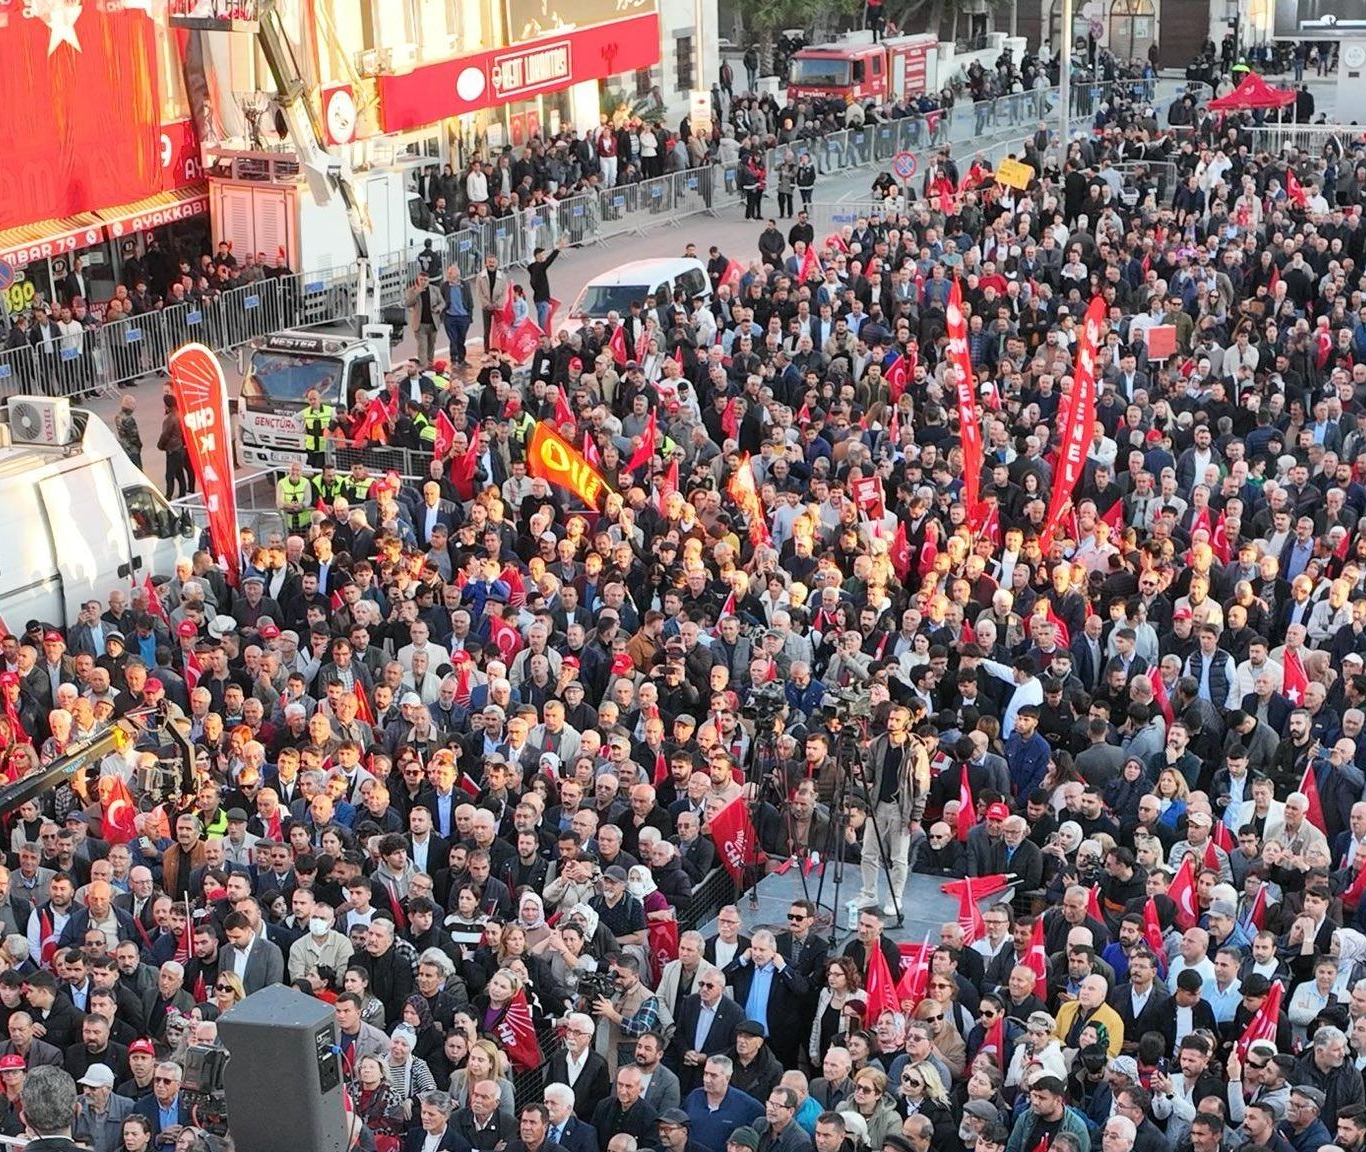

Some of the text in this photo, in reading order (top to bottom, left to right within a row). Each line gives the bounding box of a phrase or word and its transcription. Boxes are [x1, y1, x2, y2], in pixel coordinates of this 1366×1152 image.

[132, 200, 208, 233] AYAKKABI
[3, 236, 77, 266] MBAR 79
[269, 336, 317, 348] NESTER
[44, 408, 53, 442] VESTEL
